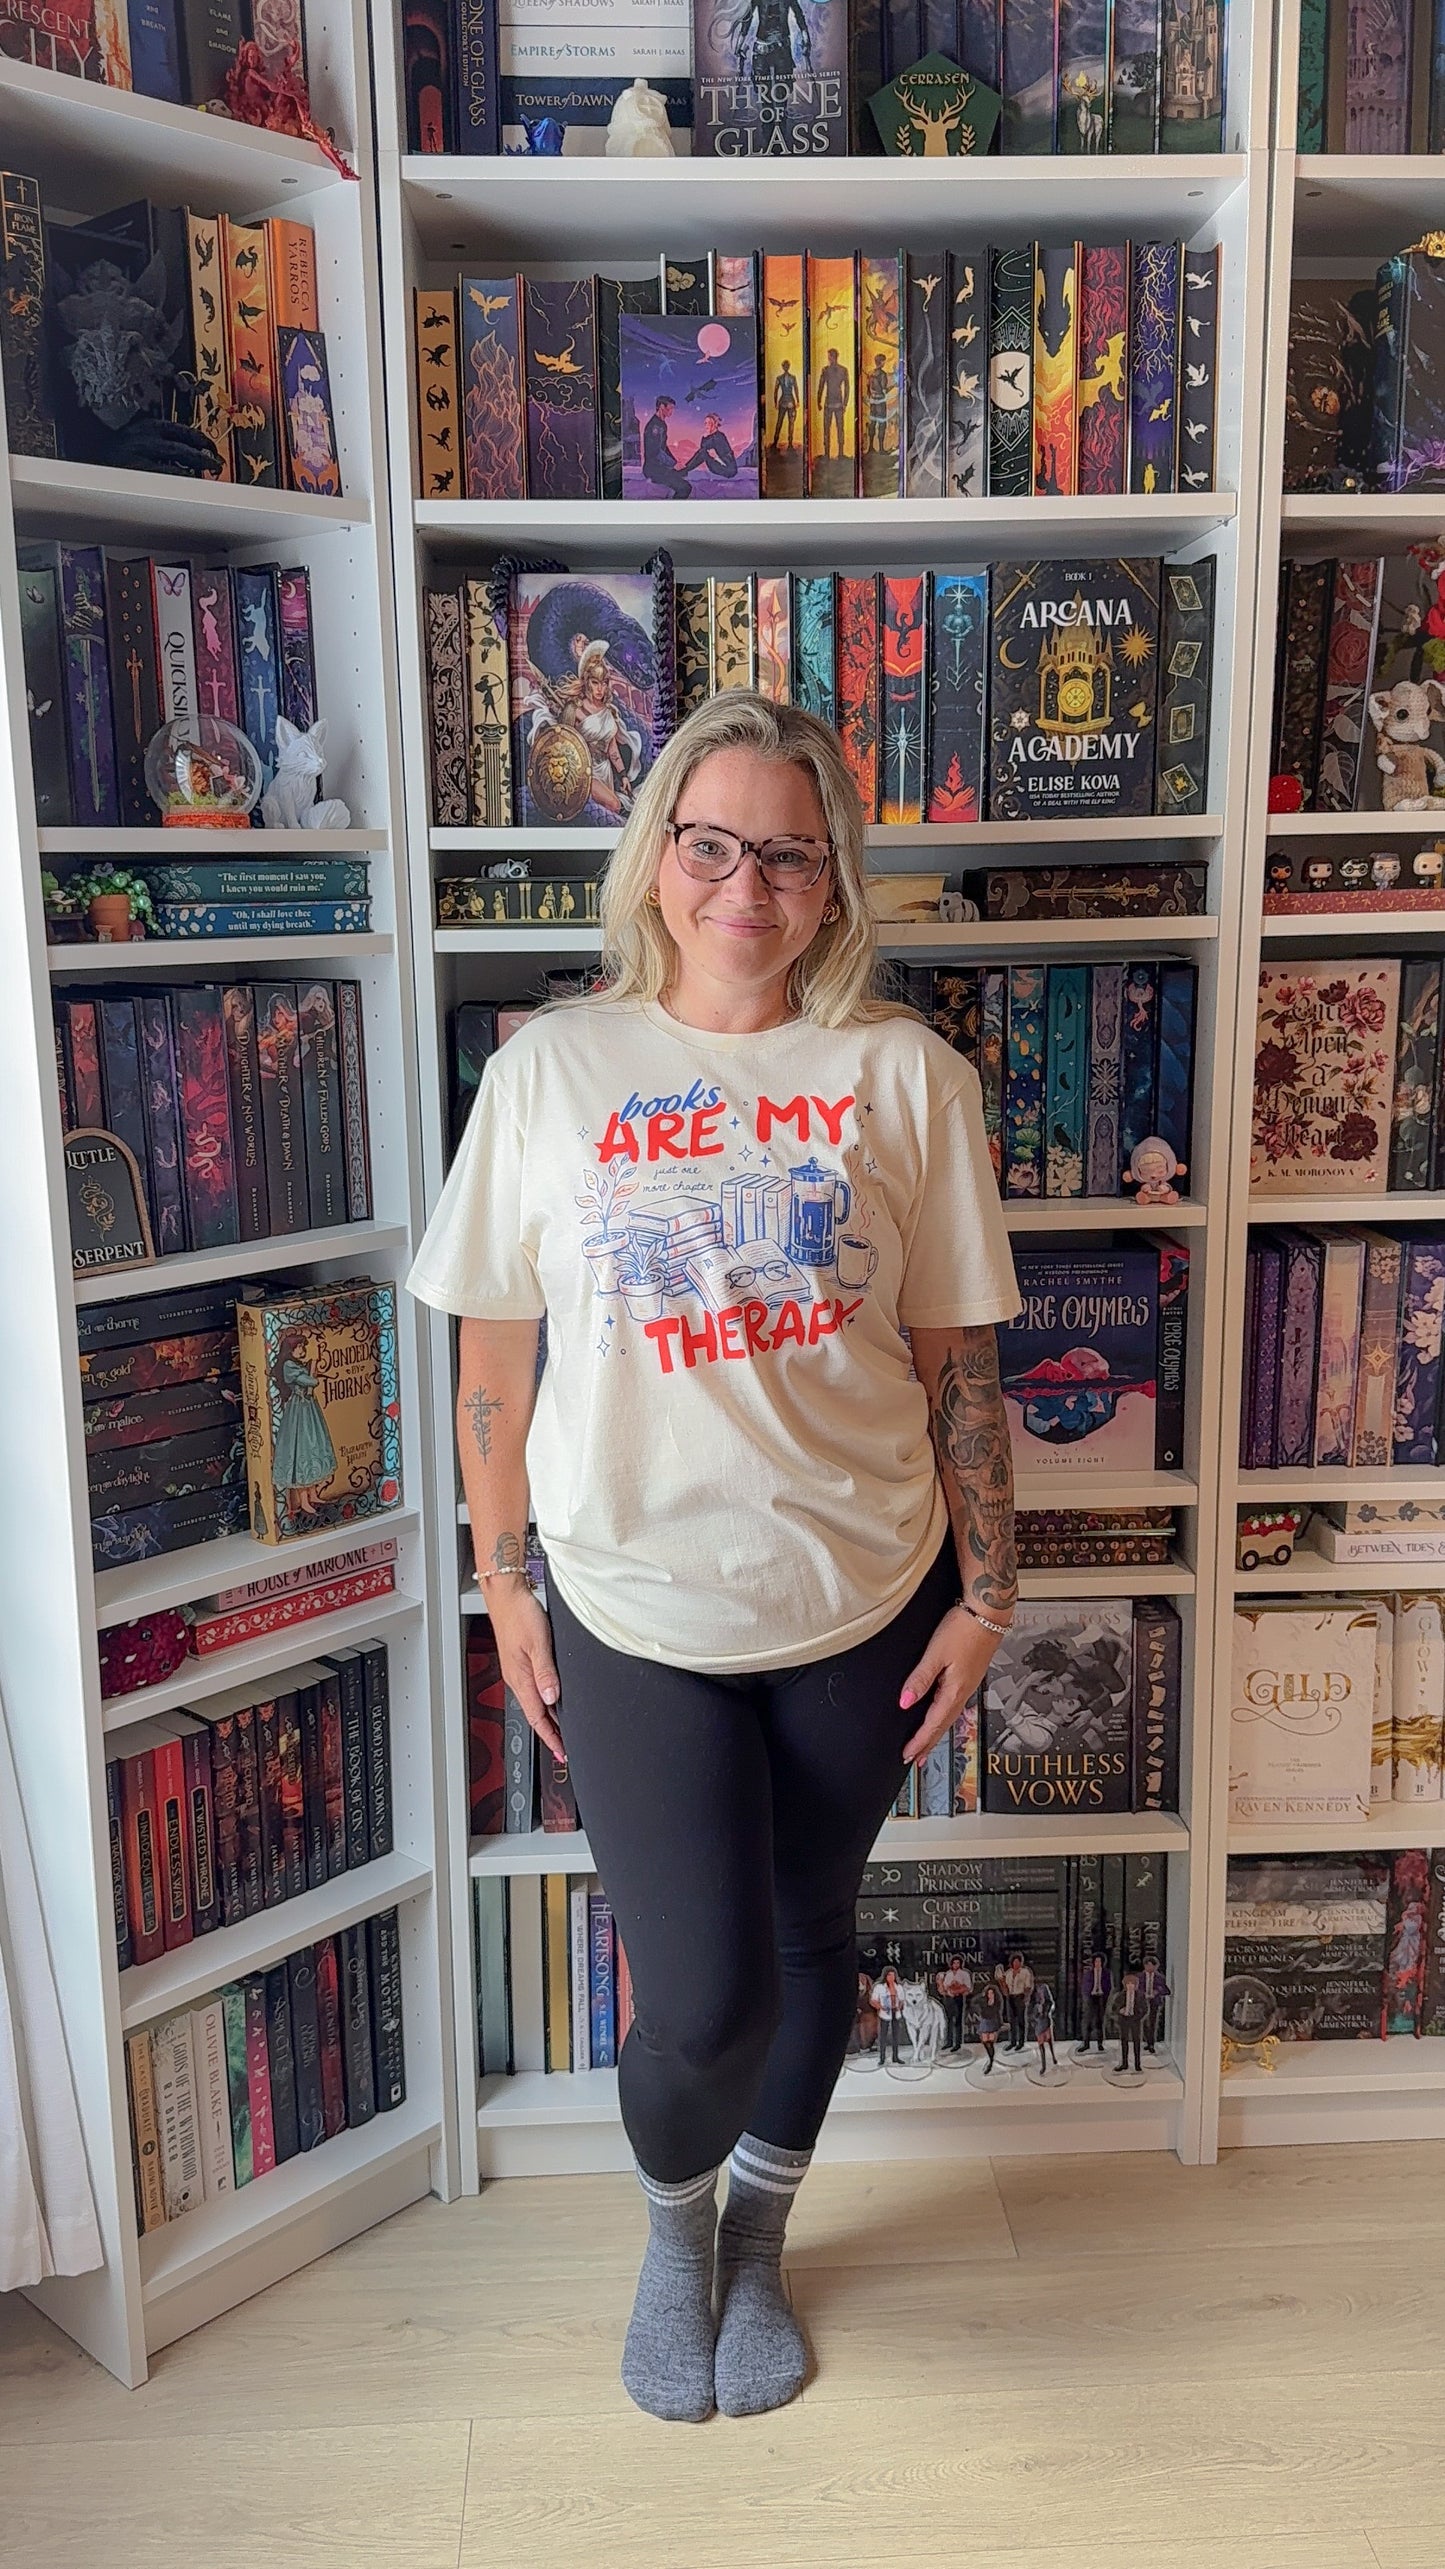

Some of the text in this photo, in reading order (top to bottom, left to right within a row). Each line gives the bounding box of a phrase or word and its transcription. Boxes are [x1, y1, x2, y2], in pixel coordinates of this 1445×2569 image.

[141, 19, 167, 32] BREATH
[208, 40, 237, 54] SHADOW
[511, 45, 555, 57] EMPIRE
[567, 45, 616, 57] STORMS
[461, 53, 469, 87] EDITION
[900, 73, 970, 85] TERRASEN
[470, 40, 486, 127] OF GLASS
[516, 94, 561, 106] TOWER
[572, 95, 614, 106] DAWN
[700, 78, 842, 126] THRONE
[759, 106, 785, 123] OF
[714, 121, 830, 157] GLASS
[12, 221, 37, 235] FLAME
[14, 213, 33, 223] IRON
[288, 241, 302, 305] YARROS
[297, 238, 310, 313] REBECCA
[1065, 572, 1086, 581] BOOK
[1020, 599, 1133, 629] ARCANA
[1008, 732, 1141, 762] ACADEMY
[1028, 774, 1121, 791] ELISE KOVA
[226, 884, 247, 893] knew
[248, 885, 263, 894] you
[264, 883, 288, 893] would
[289, 883, 306, 892] ruin
[239, 872, 256, 881] first
[257, 872, 288, 881] moment
[295, 873, 309, 881] saw
[310, 872, 327, 882] you,
[228, 921, 248, 930] until
[249, 922, 261, 931] my
[262, 920, 285, 930] dying
[256, 910, 276, 919] shall
[277, 909, 293, 918] love
[294, 909, 312, 917] thee
[1312, 1063, 1331, 1087] a
[236, 1030, 257, 1167] DAUGHTER NO WORLDS
[314, 1028, 331, 1153] CHILDREN FALLEN GODS
[619, 1078, 721, 1123] books
[276, 1037, 295, 1171] MOTHER DEATH DAWN
[594, 1095, 856, 1163] ARE MY
[65, 1147, 117, 1169] LITTLE
[653, 1164, 701, 1176] just one
[1295, 1168, 1354, 1177] MORONOVA
[642, 1181, 714, 1194] more chapter
[73, 1241, 144, 1268] SERPENT
[1023, 1276, 1123, 1286] RACHEL SMYTHE
[159, 1305, 215, 1320] ELIZABETH HELEN
[1061, 1295, 1150, 1339] OLYMPUS
[644, 1297, 864, 1374] THERAPY
[316, 1342, 371, 1372] BONDED
[352, 1365, 361, 1375] BY
[317, 1373, 372, 1409] THORNS
[168, 1404, 202, 1416] ELIZABETH
[108, 1415, 144, 1431] malice
[170, 1459, 204, 1471] ELIZABETH
[1348, 1541, 1435, 1557] BETWEEN TIDES
[247, 1572, 290, 1598] HOUSE
[305, 1546, 369, 1580] MARIONNE
[1079, 1613, 1121, 1625] ROSS
[1243, 1669, 1352, 1706] GILD
[347, 1717, 364, 1807] THE BOOK OF
[370, 1704, 387, 1827] BLOOD RAINS DOWN
[987, 1753, 1126, 1776] RUTHLESS
[1006, 1779, 1105, 1806] VOWS
[1235, 1802, 1351, 1816] RAVEN KENNEDY
[195, 1806, 210, 1901] TWISTED THRONE
[314, 1826, 322, 1859] JAYMIN
[138, 1819, 152, 1900] INADEQUATE
[145, 1901, 156, 1929] HEIR
[168, 1818, 184, 1908] ENDLESS WAR
[918, 1862, 984, 1877] SHADOW
[110, 1837, 124, 1924] TRAITOR QUEEN
[862, 1873, 874, 1882] 4
[919, 1876, 984, 1893] PRINCESS
[860, 1911, 875, 1920] 5
[922, 1899, 981, 1915] CURSED
[1232, 1910, 1287, 1918] KINGDOM
[932, 1914, 973, 1930] FATES
[1225, 1918, 1295, 1928] FLESH FIRE
[380, 1929, 388, 1947] AND
[577, 1925, 585, 1955] WHERE
[591, 1902, 613, 1997] HEARTSONG
[931, 1935, 977, 1951] FATED
[1129, 1927, 1142, 1964] STARS
[1236, 1944, 1279, 1953] CROWN
[1259, 1954, 1295, 1963] BONES
[389, 1952, 402, 2008] KNIGHT
[577, 1956, 585, 1992] DREAMS
[381, 1973, 393, 2019] MOTH
[1276, 1984, 1318, 1997] QUEENS
[325, 1988, 337, 2058] LEGENDARY
[206, 2013, 223, 2120] OLIVIE BLAKE
[138, 2087, 153, 2134] GRADUATE
[172, 2042, 199, 2182] GODS OF THE WYRDWOOD
[165, 2108, 179, 2163] BARKER
